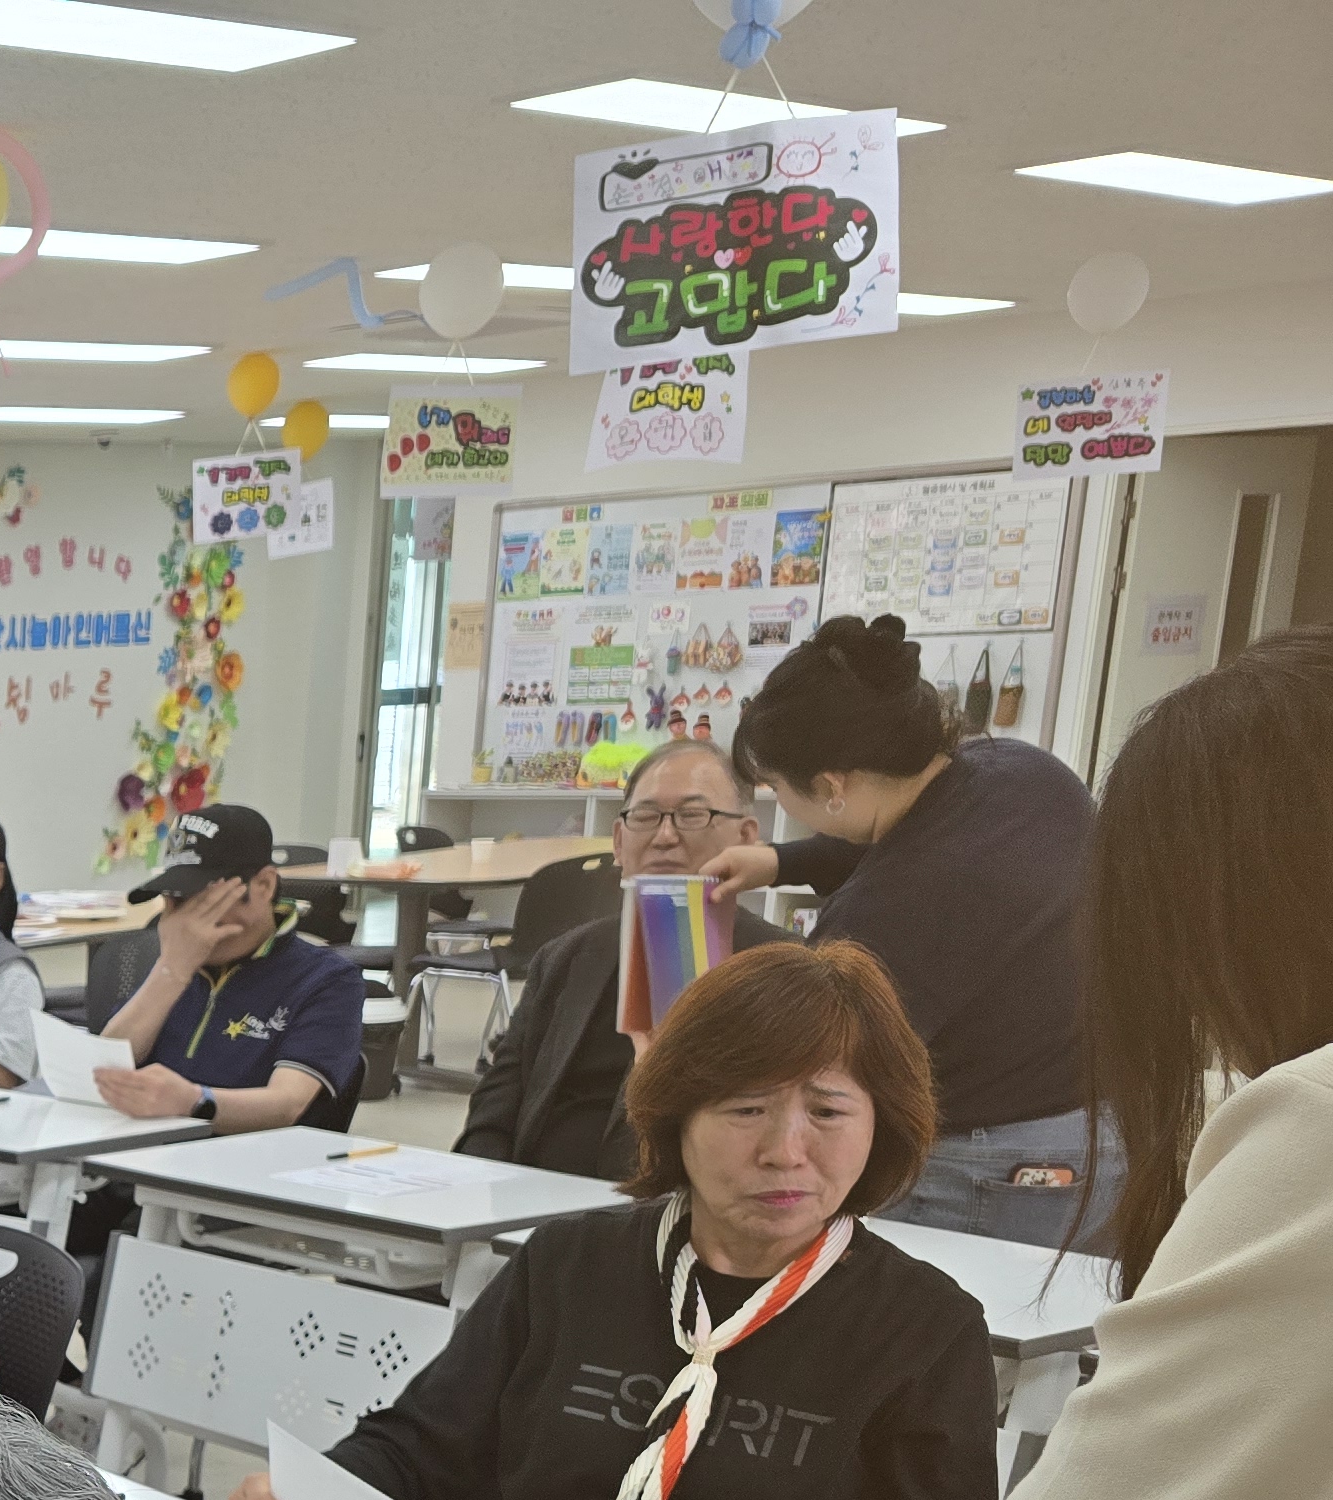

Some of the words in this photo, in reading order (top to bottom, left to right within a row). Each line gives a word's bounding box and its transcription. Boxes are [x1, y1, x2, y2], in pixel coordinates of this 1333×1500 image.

[620, 192, 835, 262] 사랑한다
[624, 258, 838, 338] 고맙다
[630, 382, 705, 414] 대학생
[1056, 409, 1113, 433] 열정이
[1023, 441, 1073, 466] 정말
[562, 1363, 835, 1467] ESRIT
